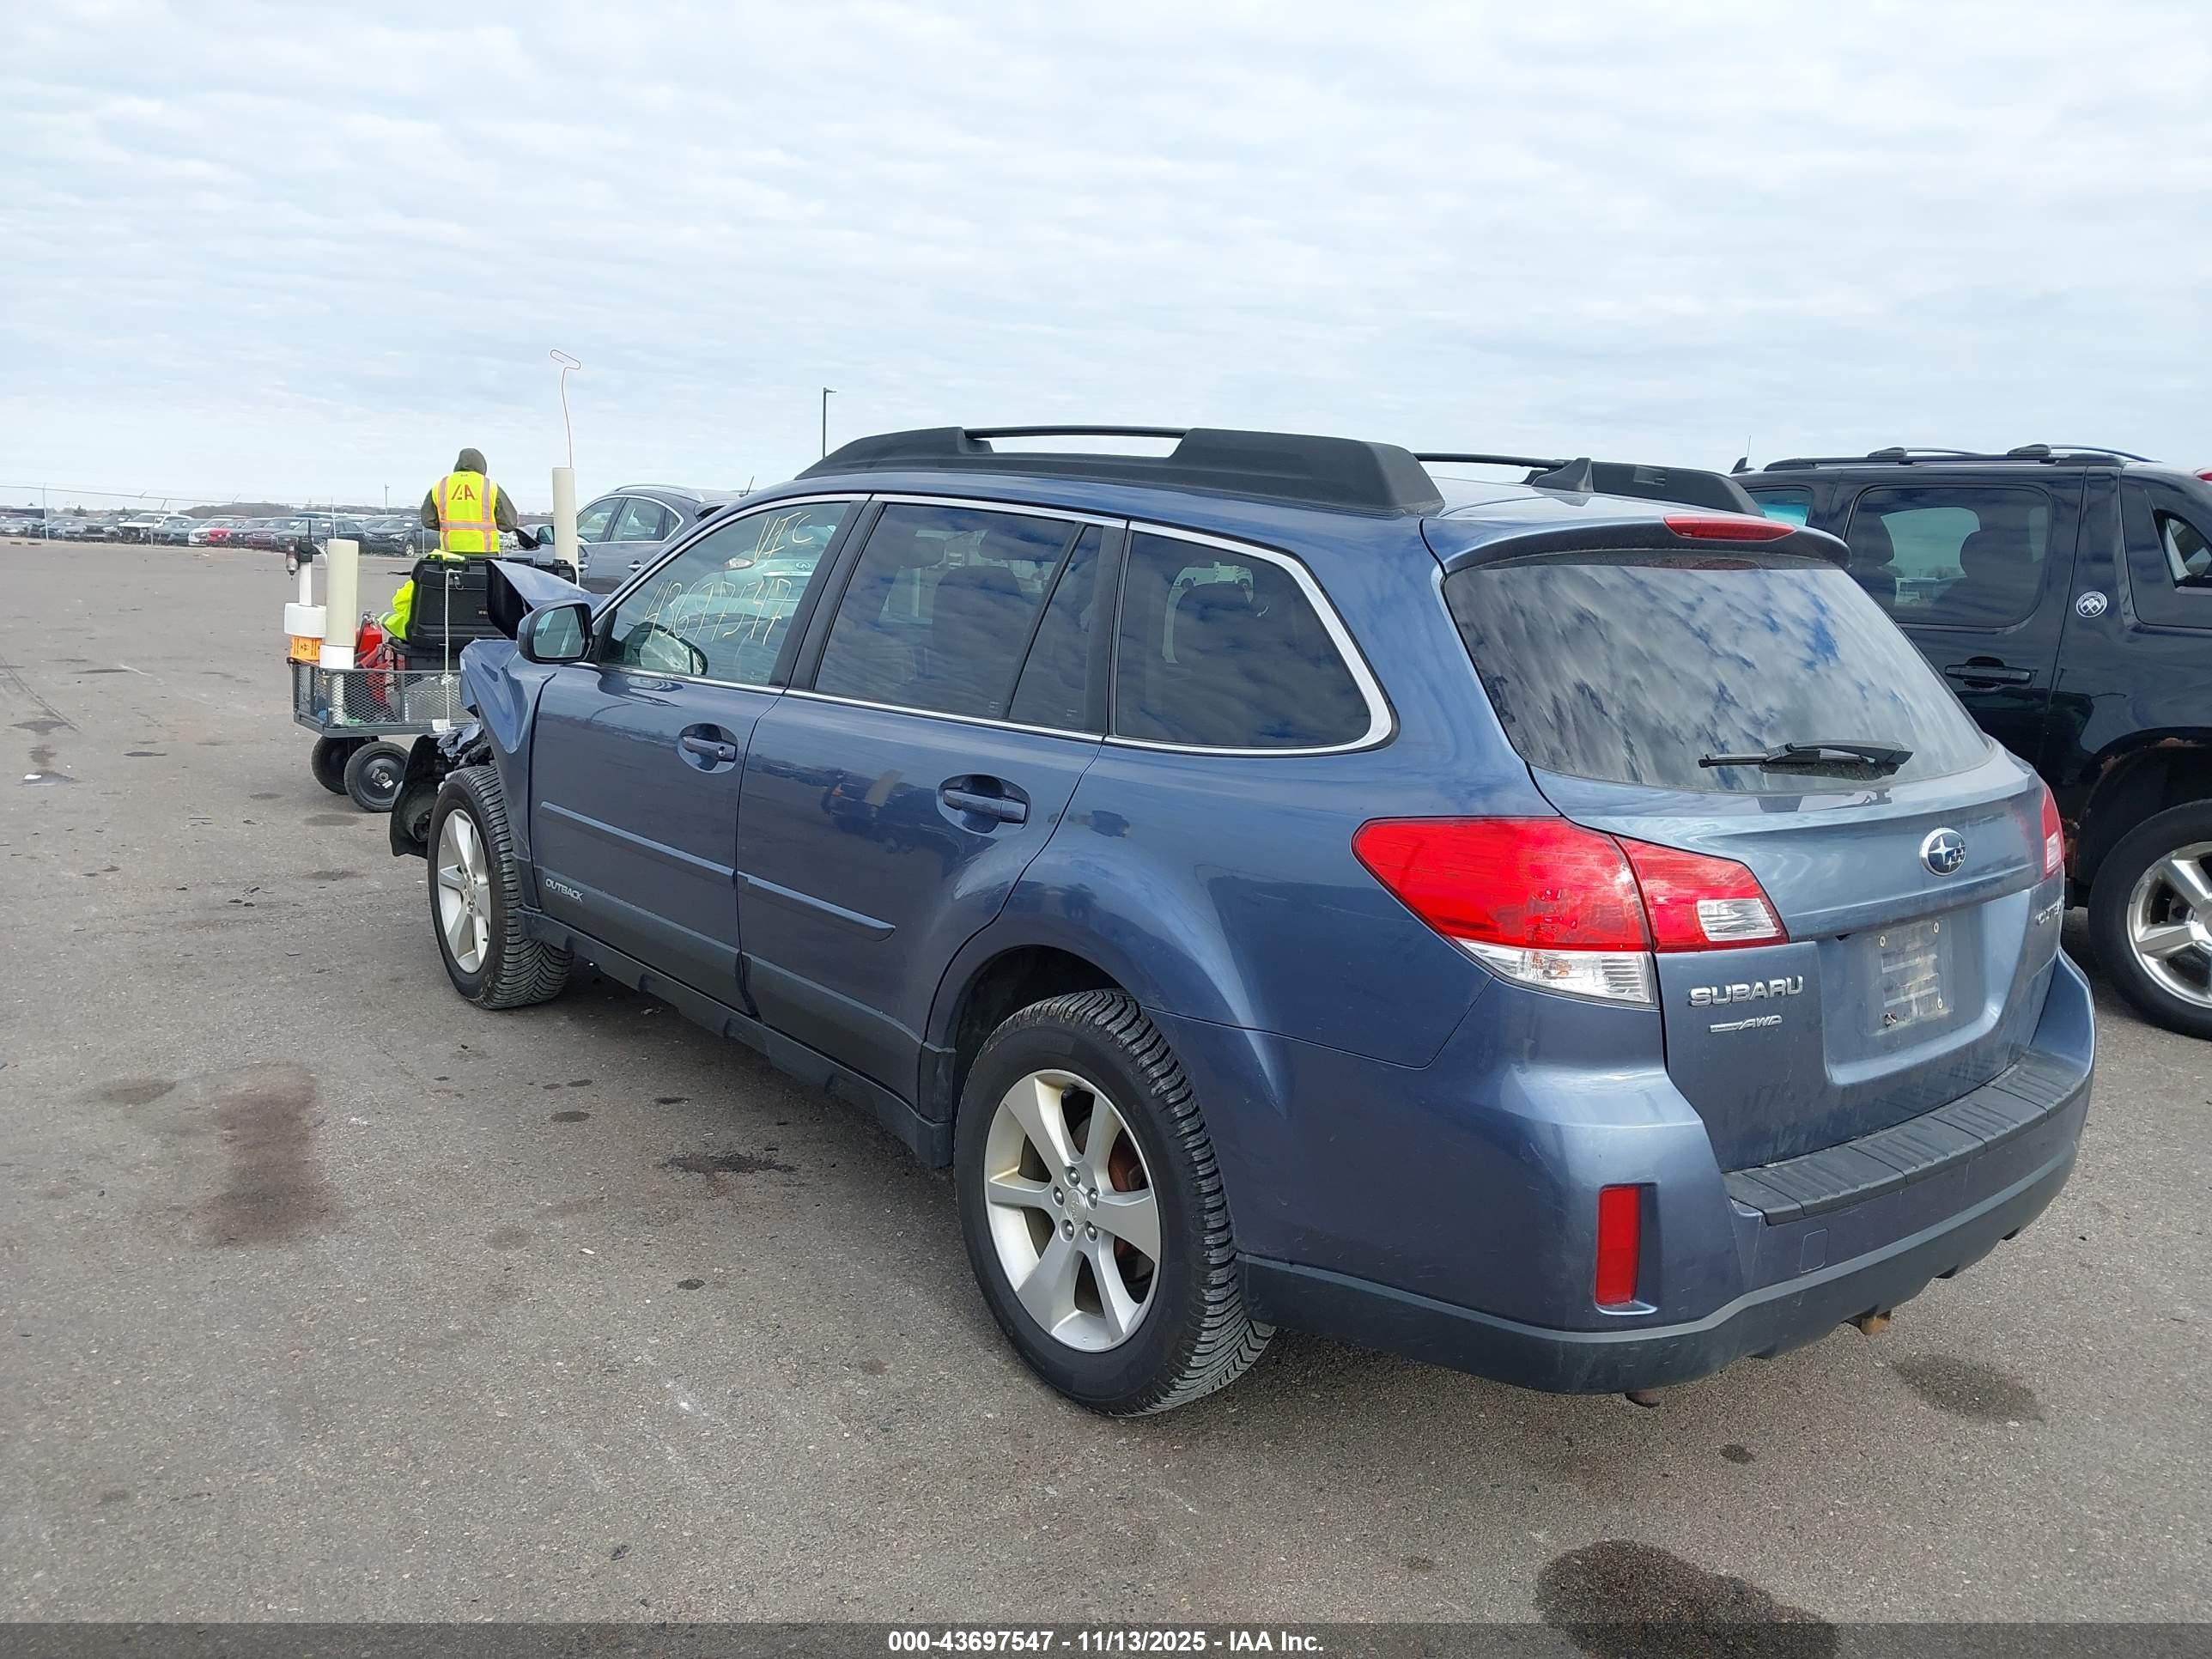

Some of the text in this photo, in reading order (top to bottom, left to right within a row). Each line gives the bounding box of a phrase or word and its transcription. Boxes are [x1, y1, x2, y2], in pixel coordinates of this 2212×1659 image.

[645, 578, 793, 646] 43697547
[545, 878, 584, 902] OUTBACK
[1690, 975, 1803, 1006] SUBARU
